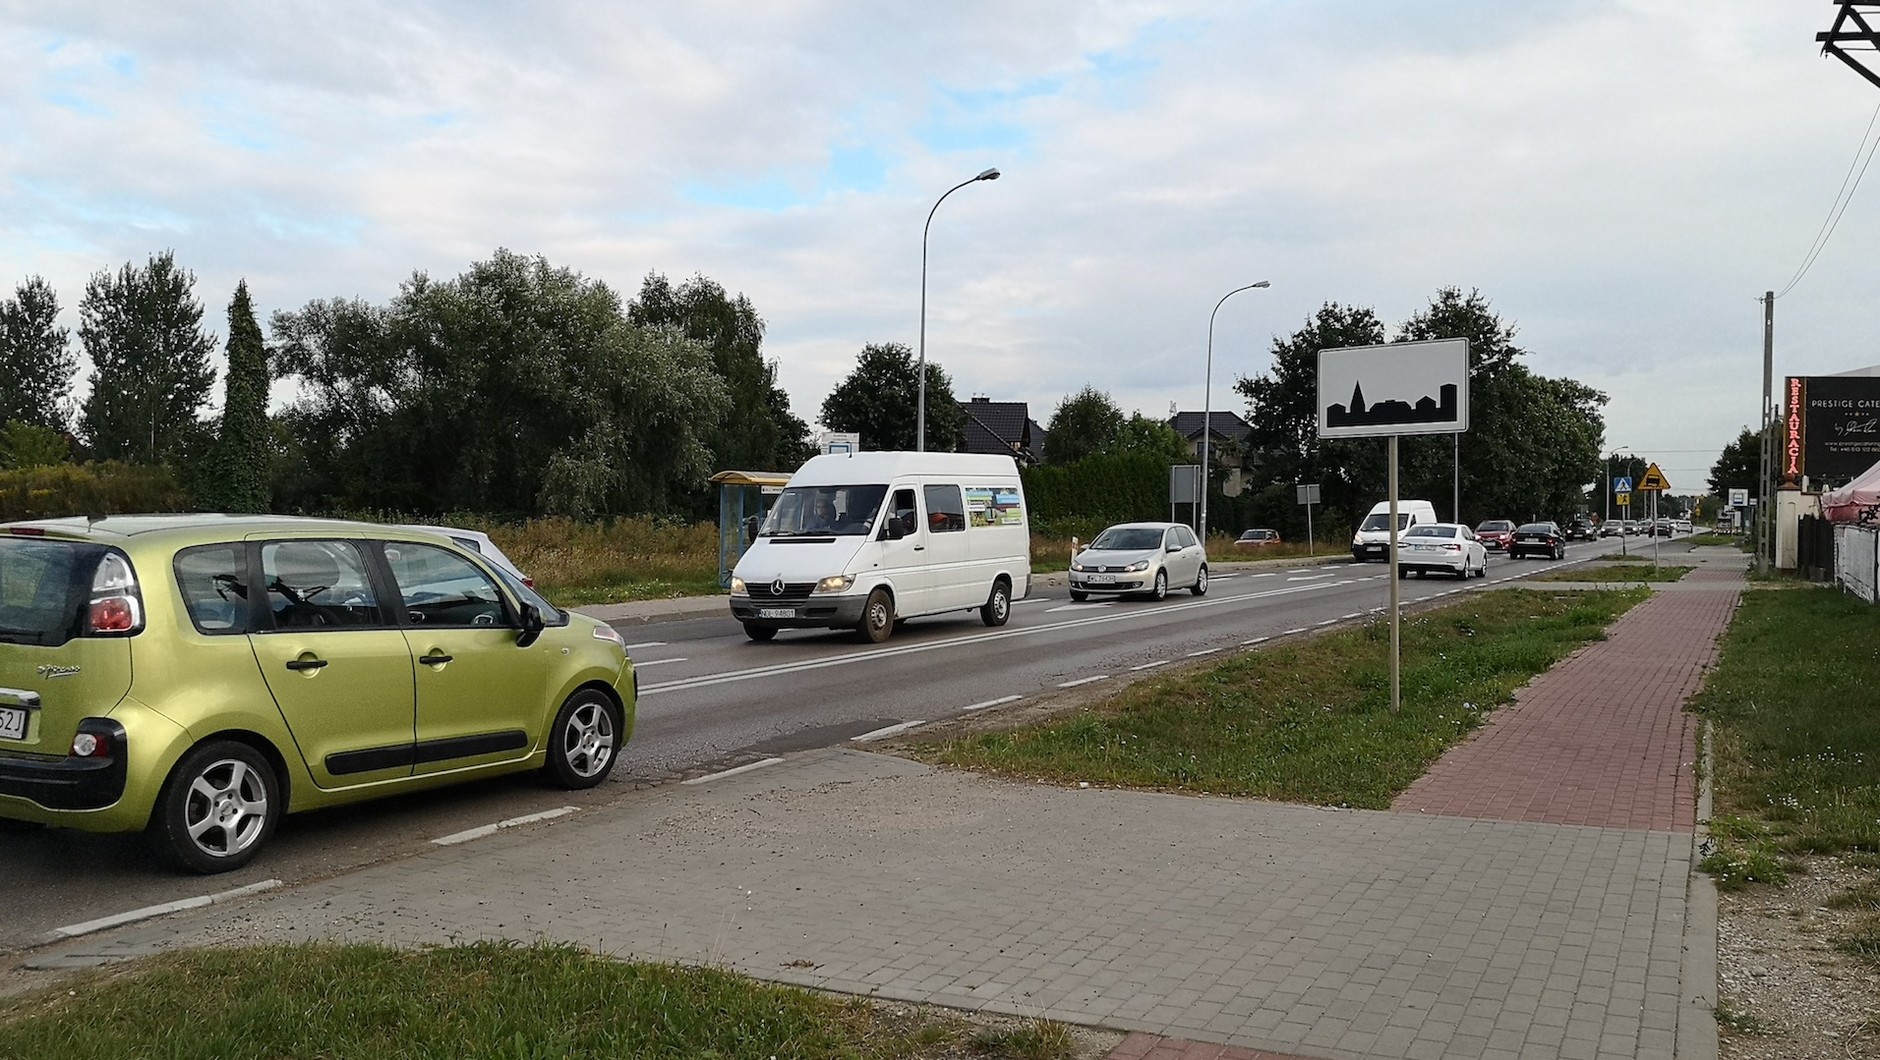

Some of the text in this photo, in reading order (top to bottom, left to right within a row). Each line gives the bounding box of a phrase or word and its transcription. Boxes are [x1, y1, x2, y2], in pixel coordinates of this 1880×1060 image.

[1788, 378, 1801, 474] RESTAURACJA
[1811, 399, 1880, 408] PRESTIGE CATE
